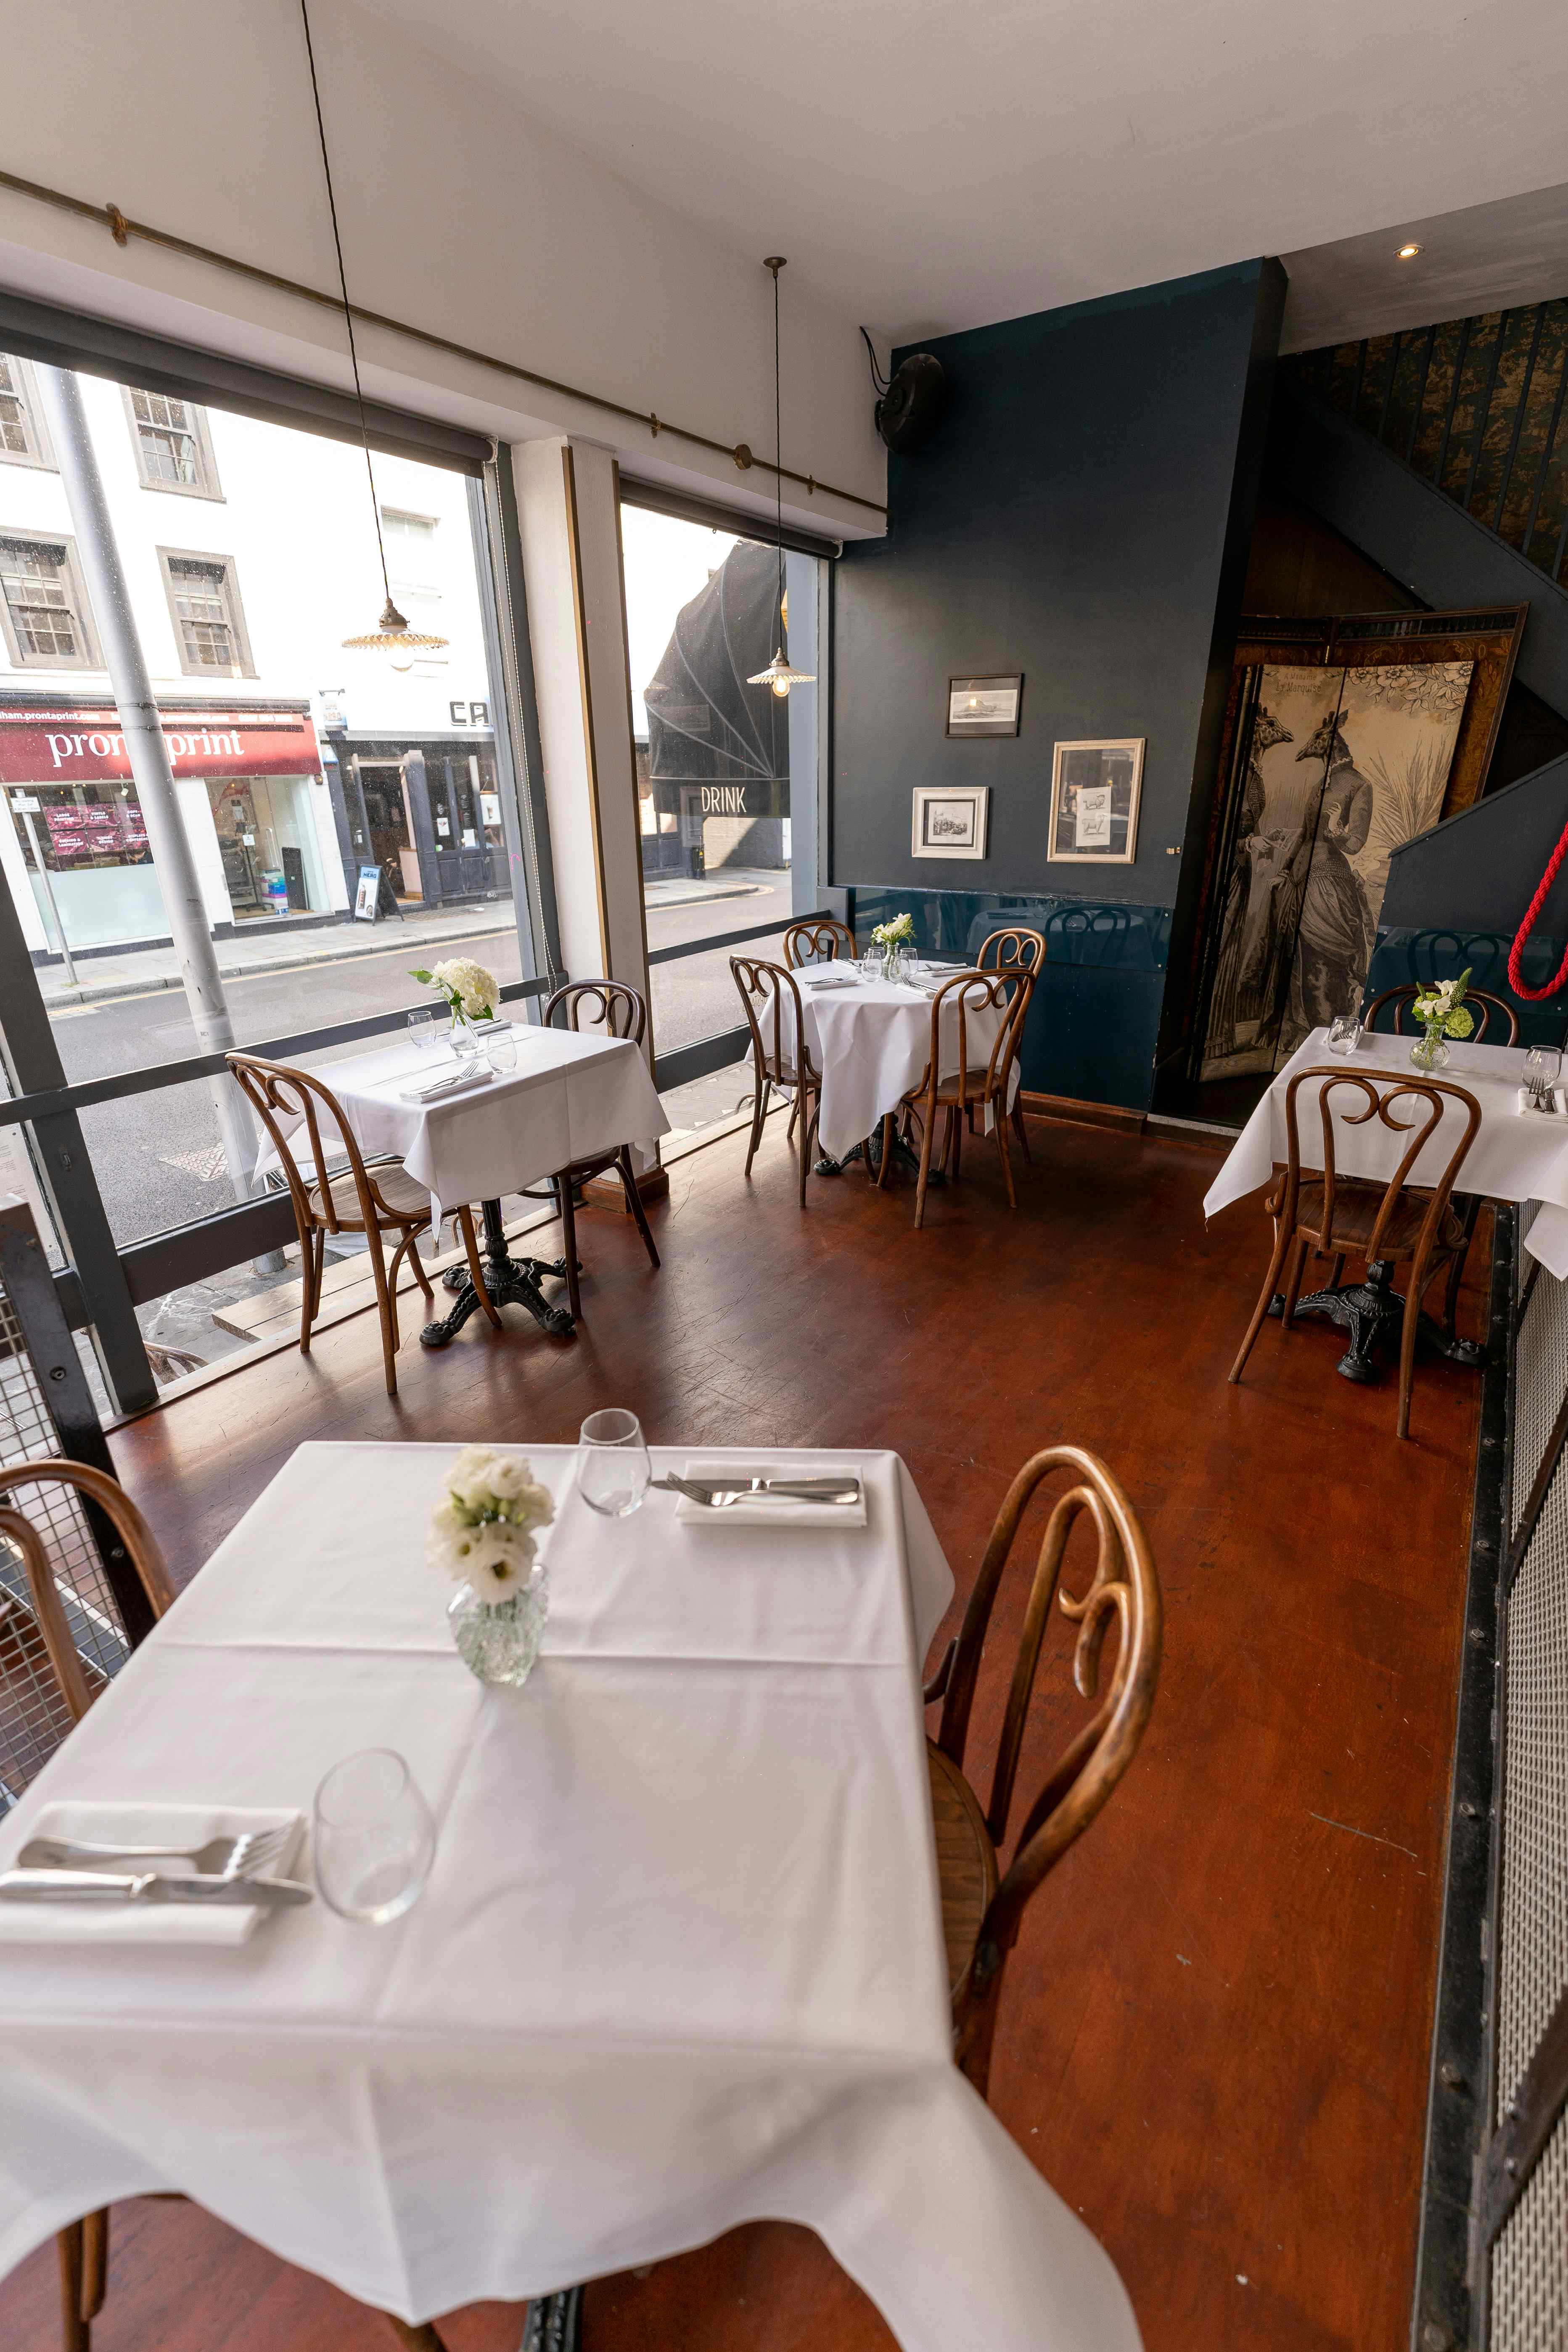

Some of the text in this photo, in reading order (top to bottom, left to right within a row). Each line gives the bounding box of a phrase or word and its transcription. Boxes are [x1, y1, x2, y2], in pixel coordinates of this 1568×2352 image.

[1287, 682, 1322, 695] Marquise
[0, 712, 100, 720] ham.prontaprint.com
[45, 728, 245, 767] pronprint
[701, 787, 747, 812] DRINK
